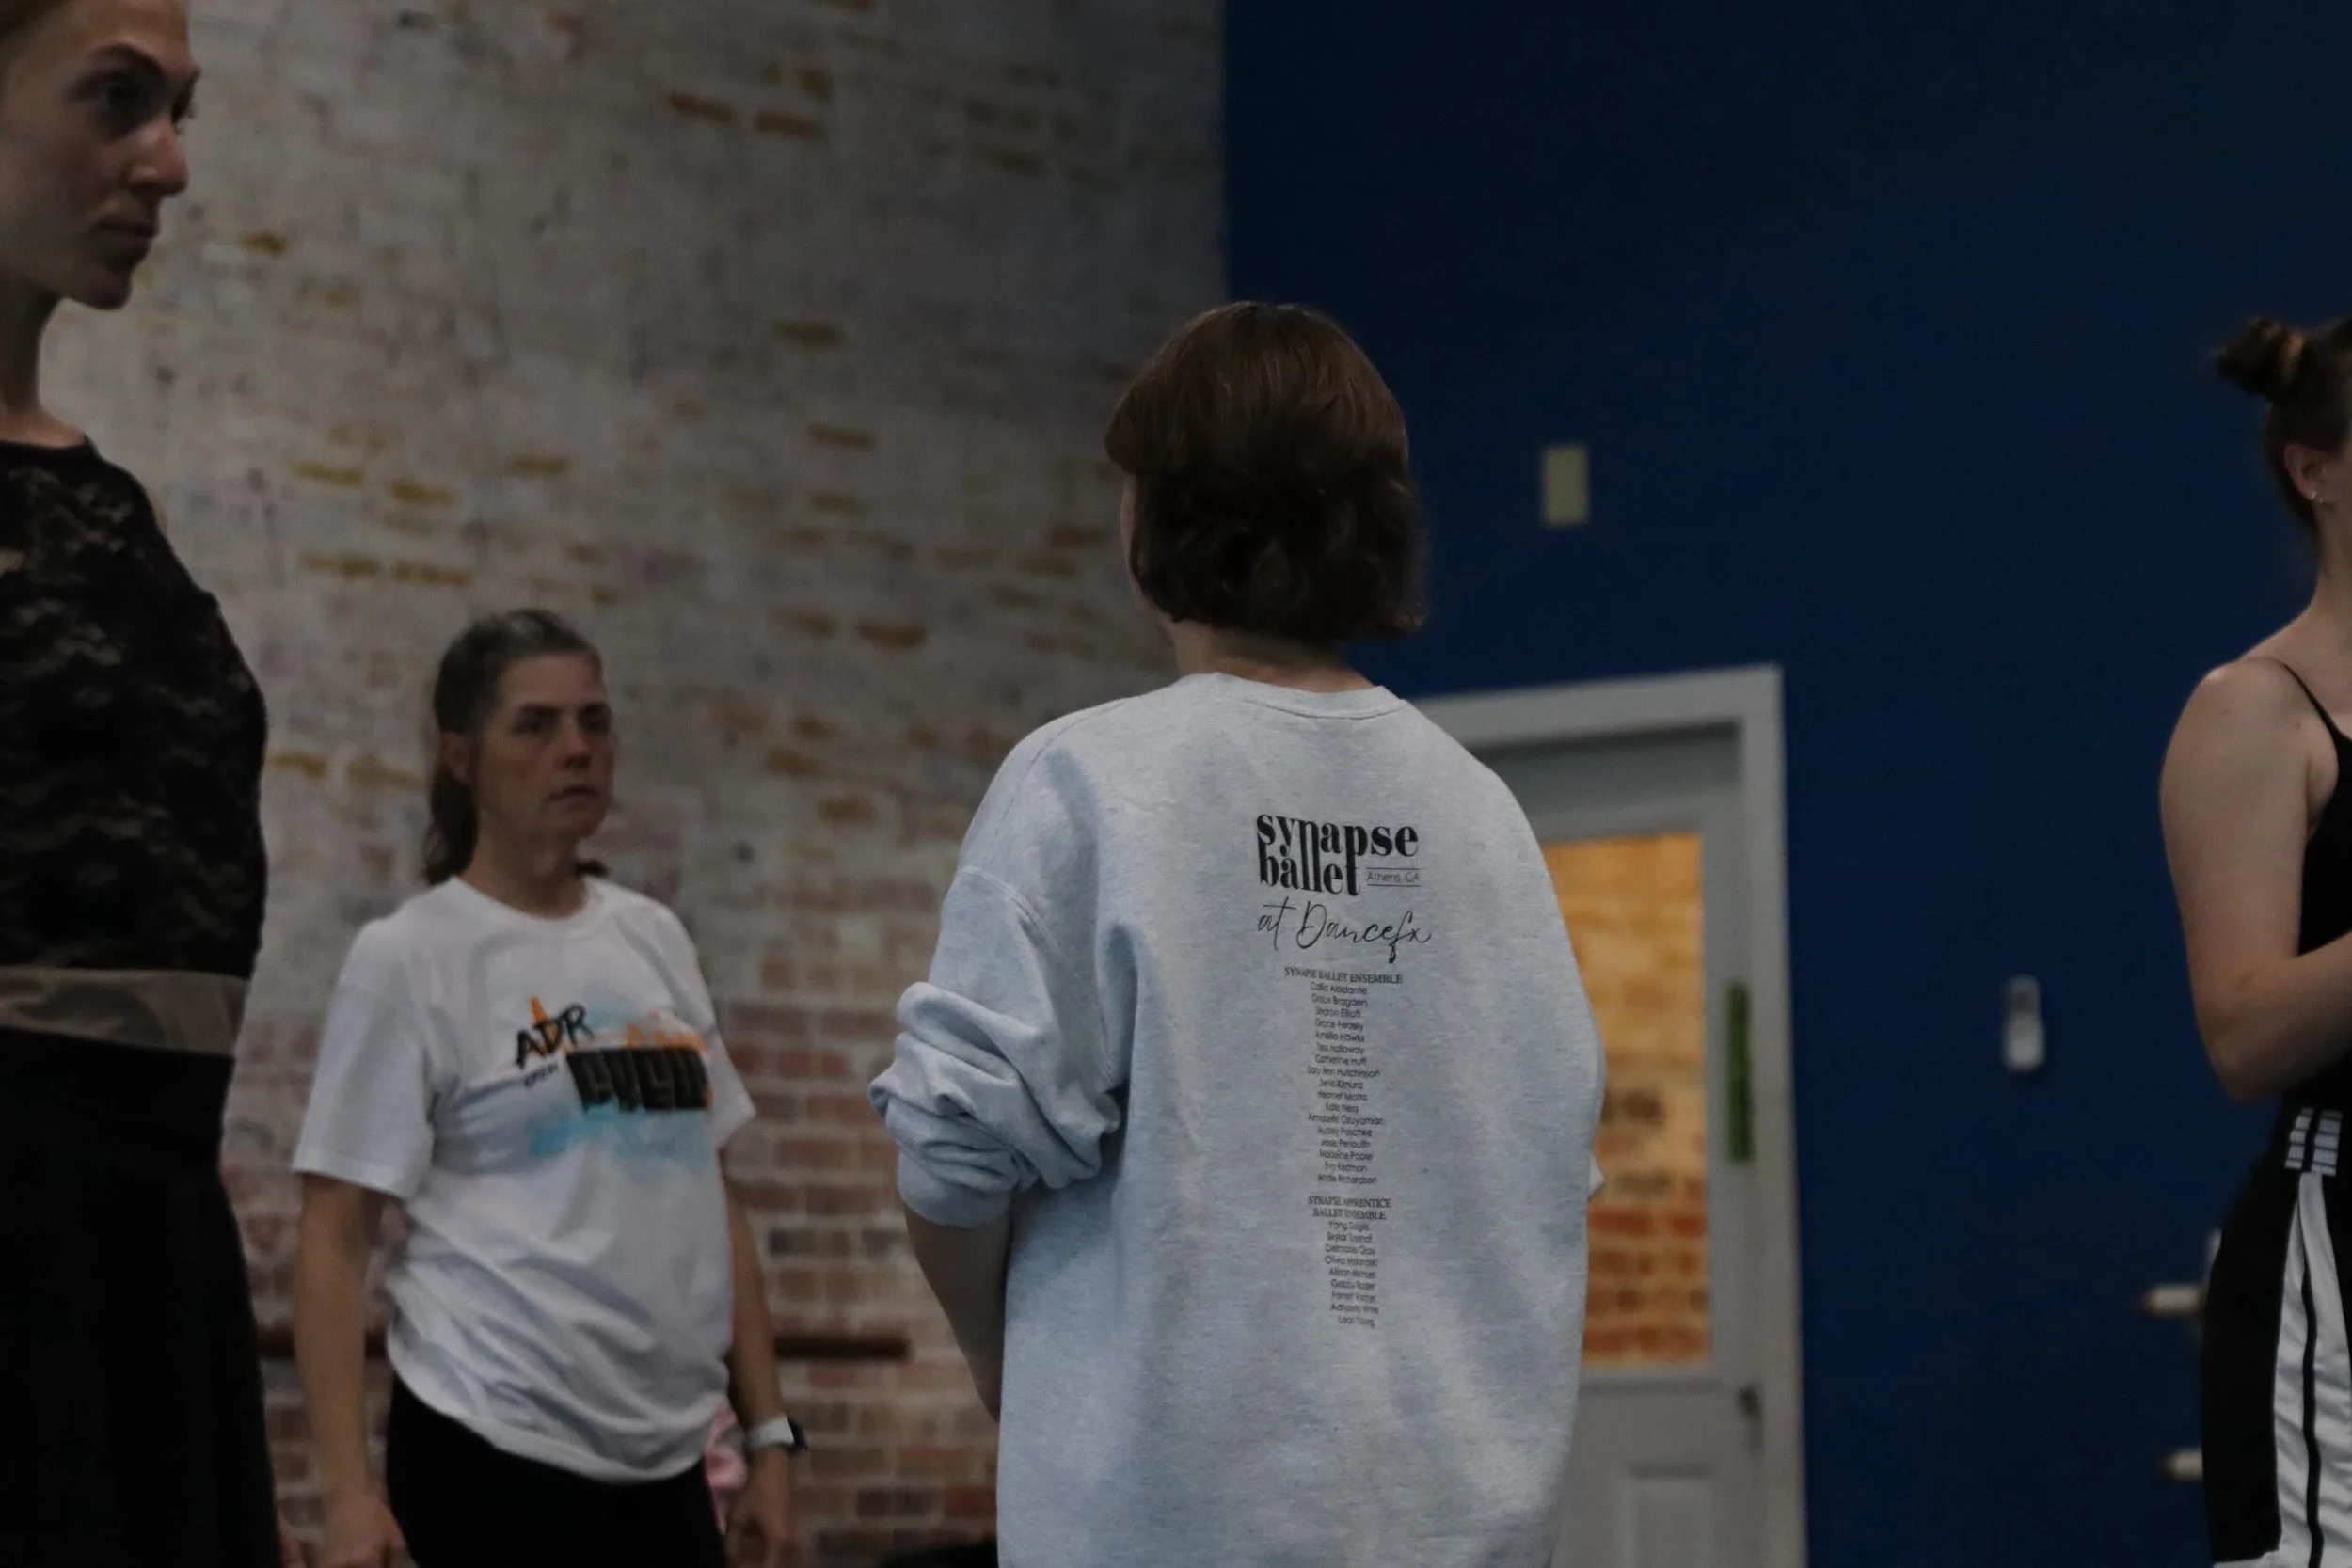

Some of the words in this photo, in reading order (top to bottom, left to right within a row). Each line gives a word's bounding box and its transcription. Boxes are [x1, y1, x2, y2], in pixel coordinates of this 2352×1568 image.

[1257, 814, 1419, 857] synapse
[1259, 840, 1361, 896] ballet
[1258, 896, 1296, 951] at
[1296, 900, 1431, 964] Dancefx
[1349, 973, 1404, 984] ENSEMBLE
